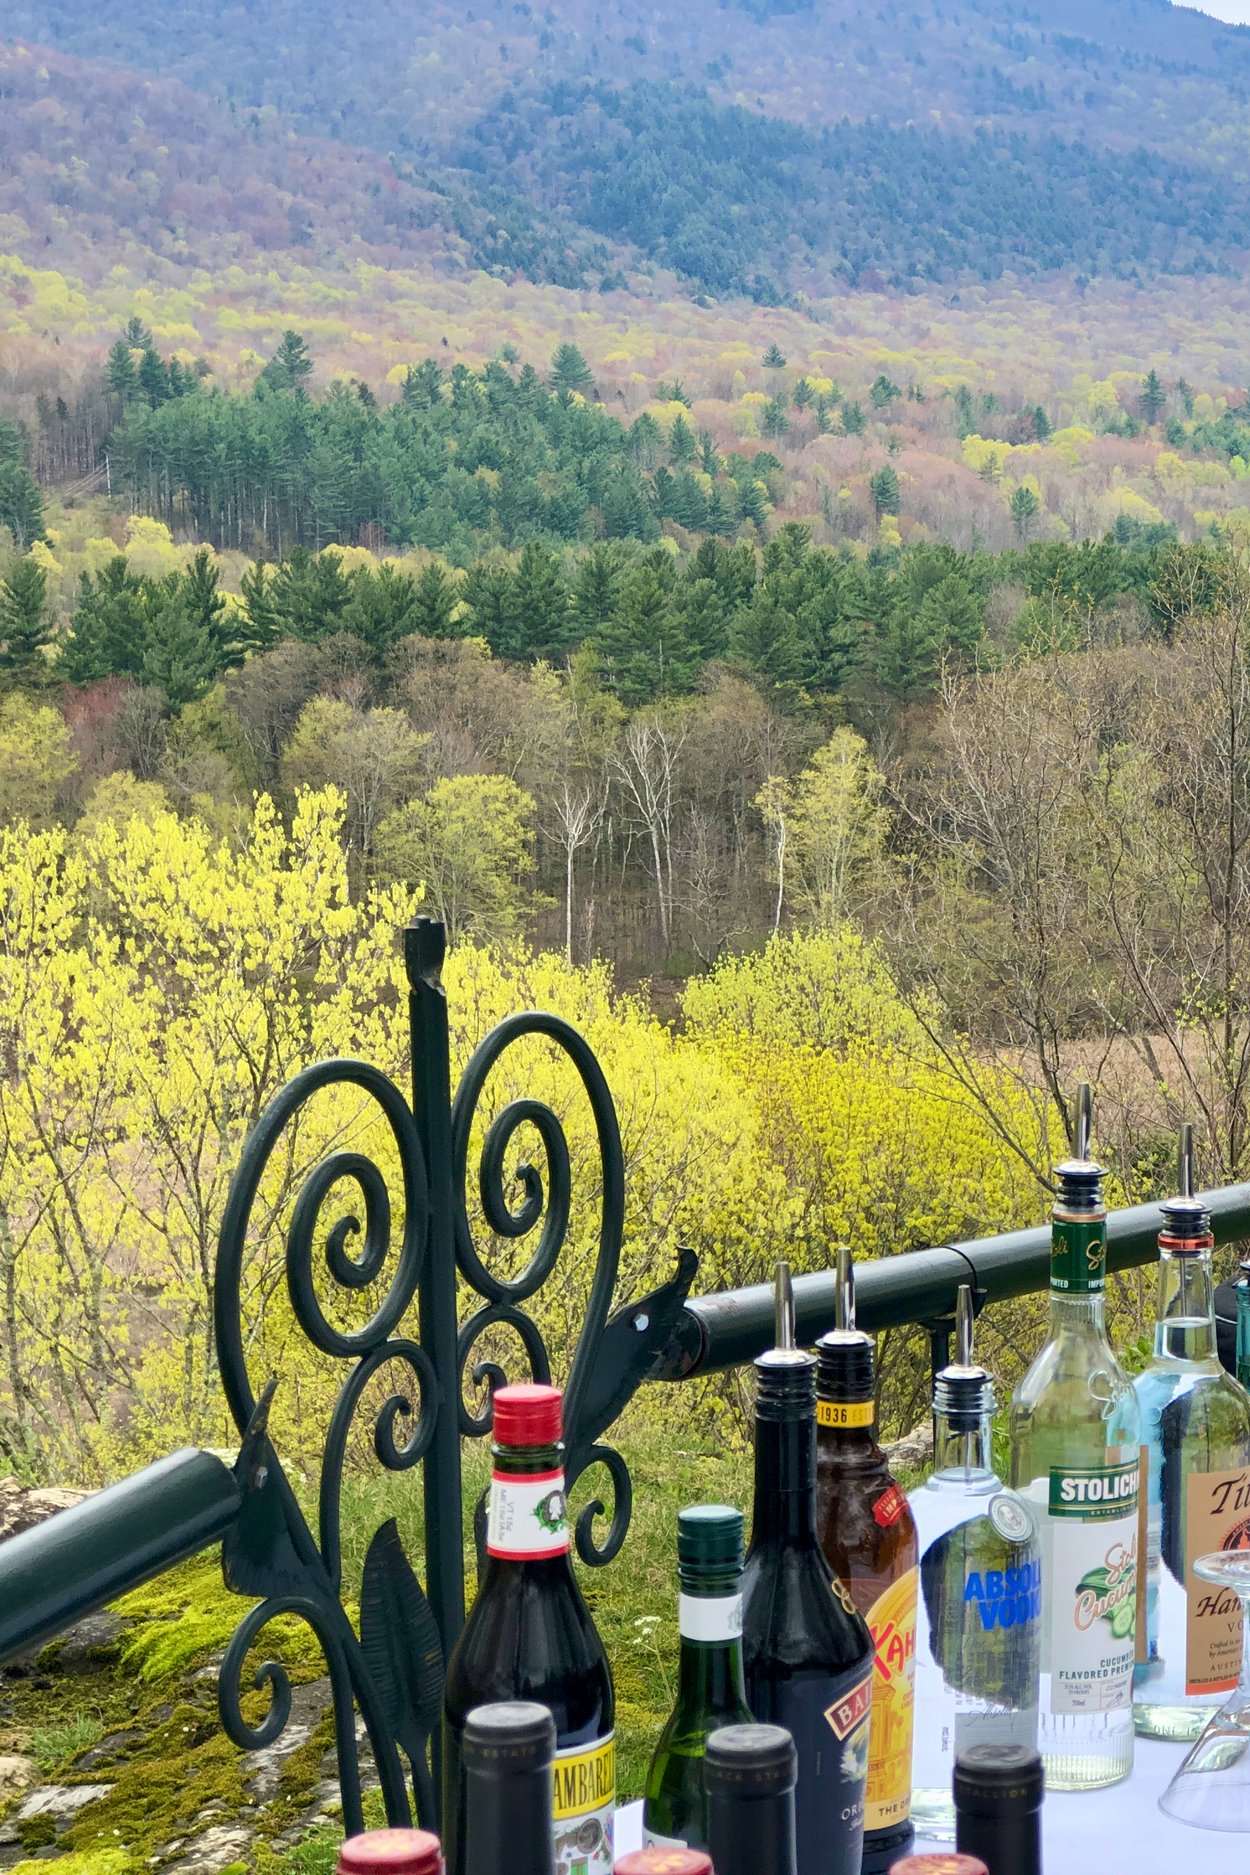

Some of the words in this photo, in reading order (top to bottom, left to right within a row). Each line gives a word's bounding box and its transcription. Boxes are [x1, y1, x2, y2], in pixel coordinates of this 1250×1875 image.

[820, 1406, 848, 1423] 1936
[1209, 1651, 1216, 1660] by
[1059, 1669, 1109, 1680] FLAVORED
[878, 1803, 898, 1817] THE
